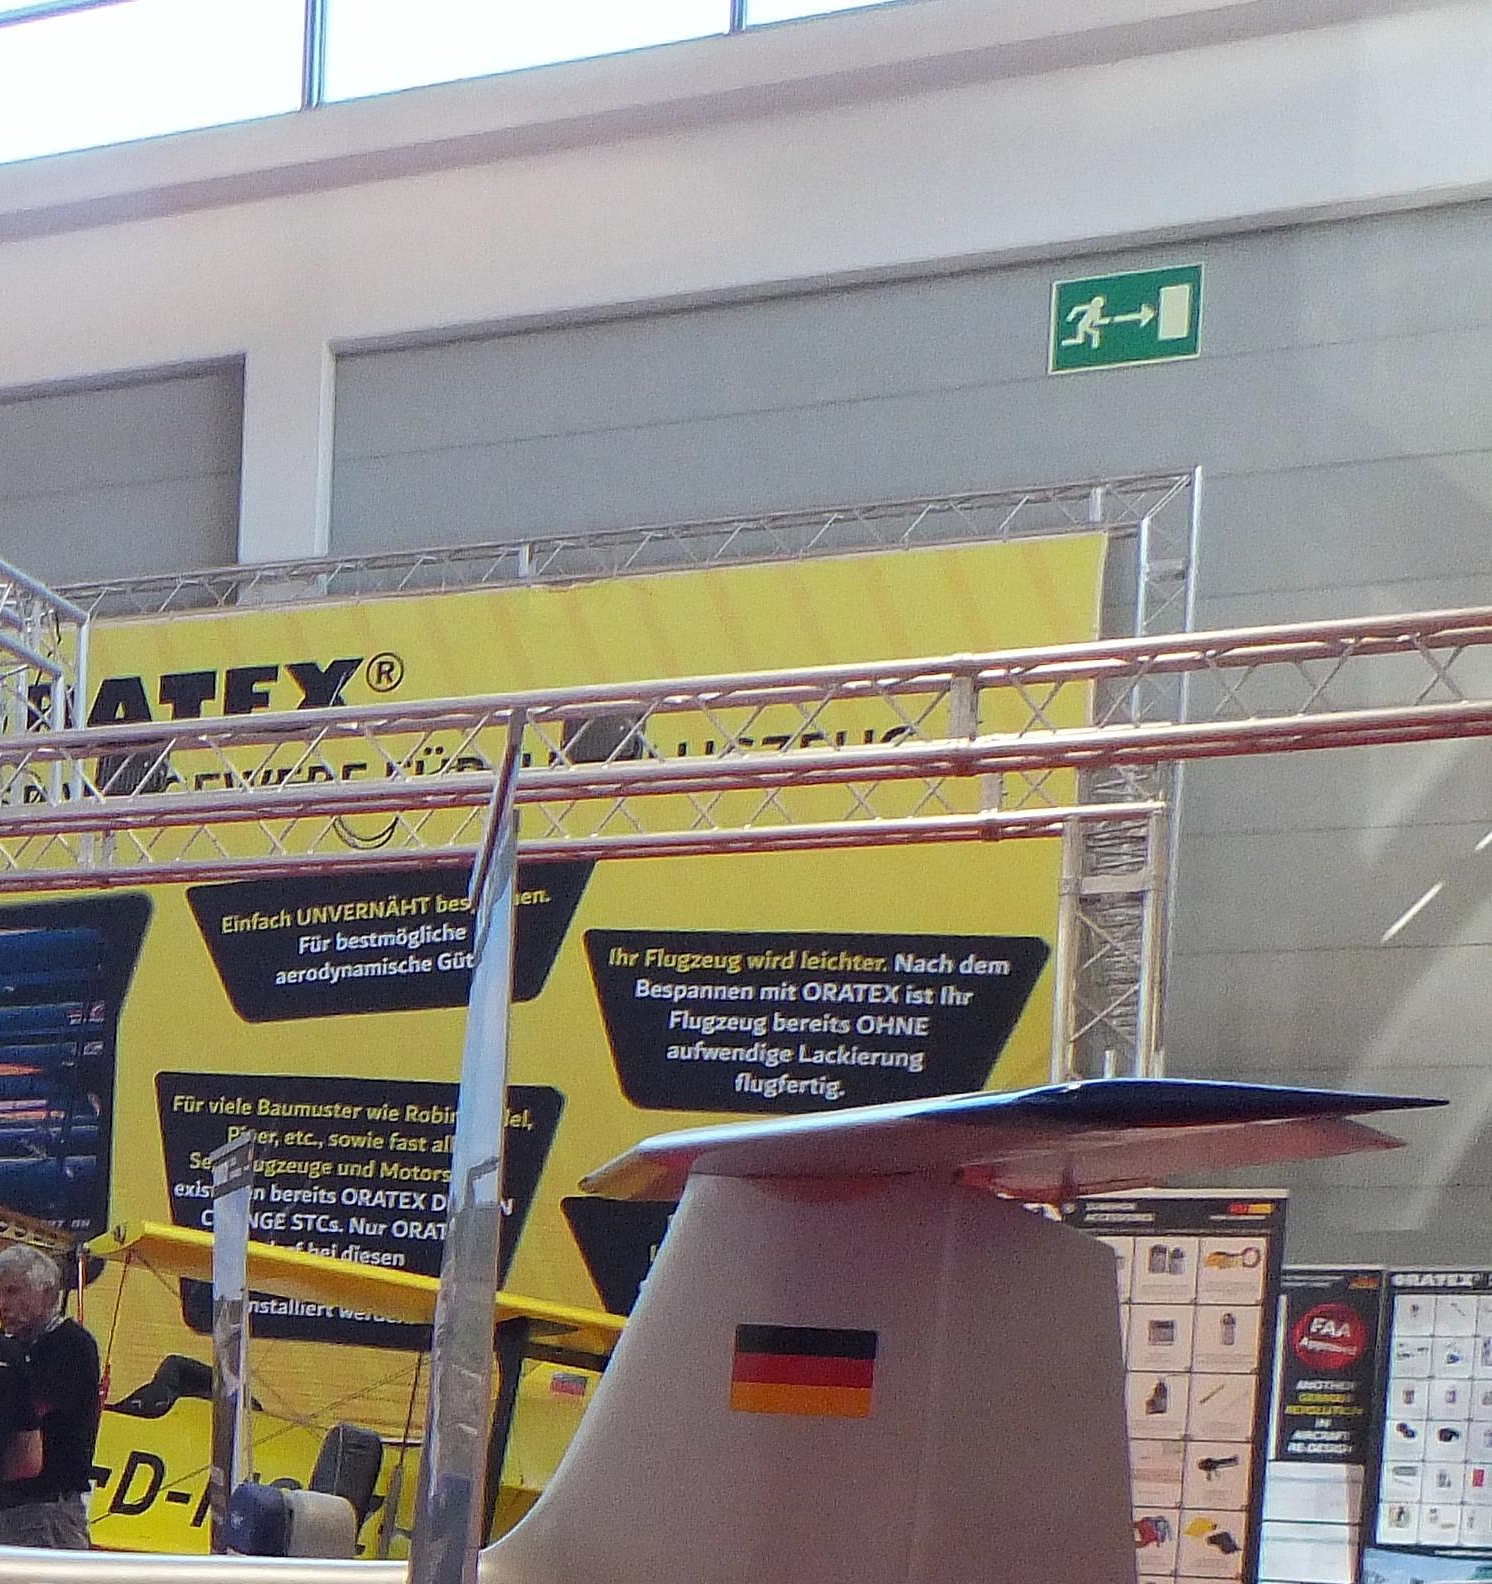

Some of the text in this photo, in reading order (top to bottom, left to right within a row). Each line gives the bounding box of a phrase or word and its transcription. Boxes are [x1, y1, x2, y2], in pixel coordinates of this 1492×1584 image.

[221, 888, 552, 934] Einfach UNVERNÄHT besen.
[299, 923, 467, 955] Für bestmögliche
[275, 950, 475, 986] aerodynamische Güt
[609, 946, 1011, 976] Ihr Flugzeug wird leichter. Nach dem
[635, 977, 975, 1007] Bespannen mit ORATEX ist Ihr
[668, 1010, 930, 1037] Flugzeug bereits OHNE
[665, 1043, 926, 1073] aufwendige Lackierung
[734, 1071, 847, 1098] flugfertig.
[173, 1094, 205, 1115] Für
[208, 1096, 253, 1117] viele
[257, 1098, 363, 1122] Baumuster
[366, 1104, 400, 1123] wie
[404, 1104, 458, 1125] Robi
[228, 1125, 456, 1154] Per, etc., sowie fast all
[189, 1151, 452, 1183] Seugzeuge und Motors
[269, 1183, 337, 1204] bereits
[341, 1187, 425, 1210] ORATEX
[200, 1209, 449, 1241] CNGE STCs. Nur ORAT
[340, 1243, 406, 1267] diesen
[248, 1296, 334, 1318] nstalliert
[1309, 1317, 1352, 1338] FAA
